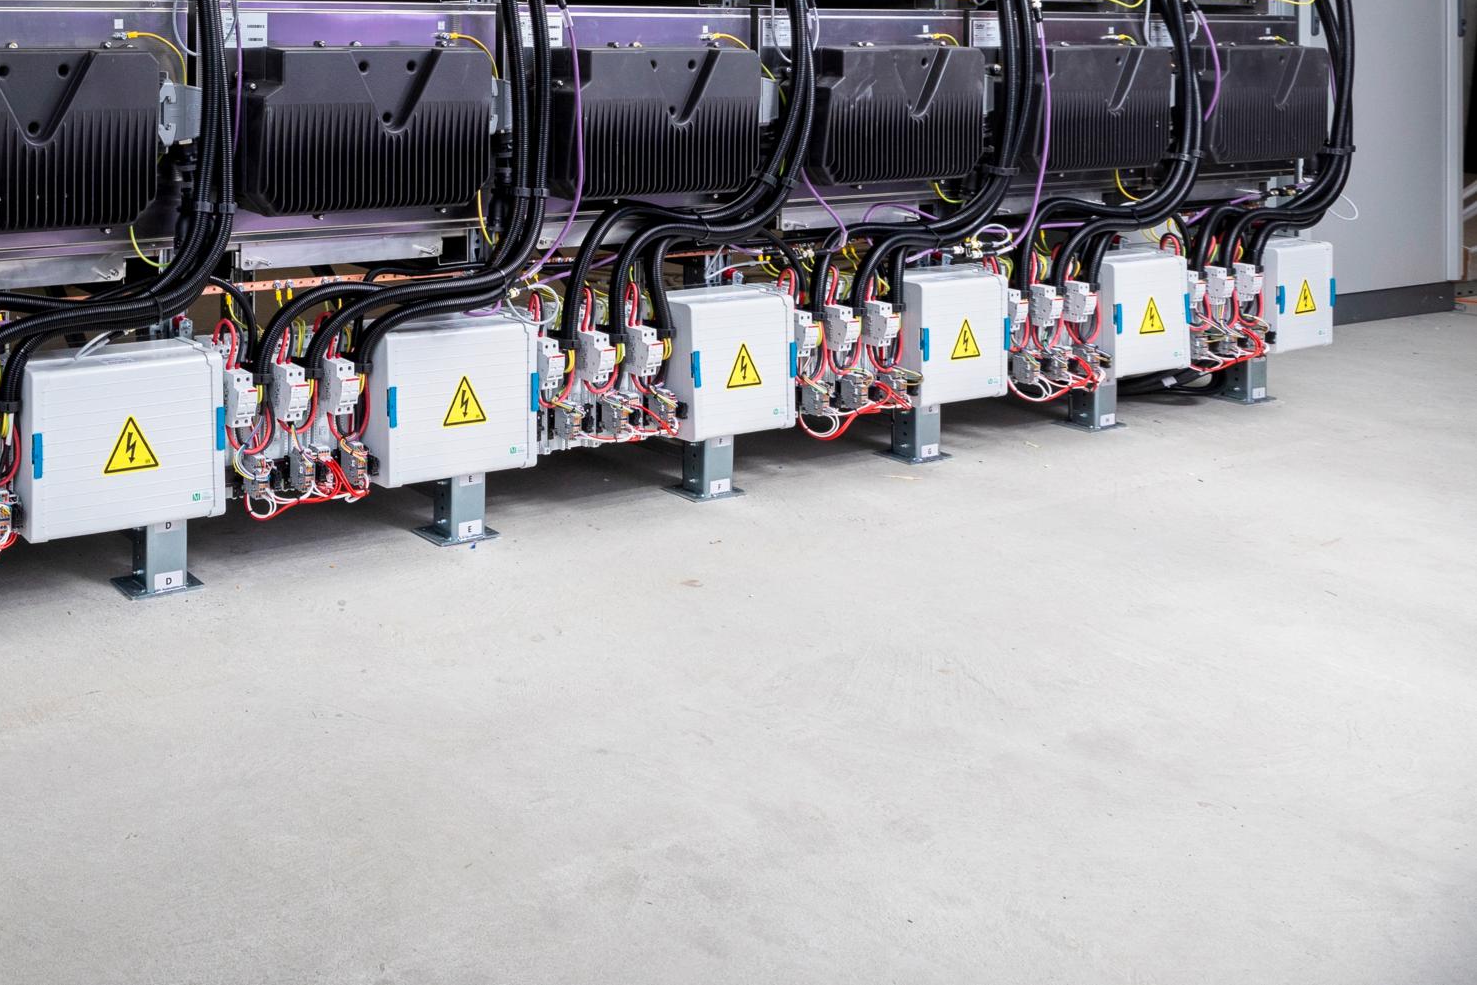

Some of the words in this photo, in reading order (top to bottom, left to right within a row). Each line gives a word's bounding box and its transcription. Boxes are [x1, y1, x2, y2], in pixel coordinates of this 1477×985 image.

[468, 475, 473, 483] E
[165, 521, 172, 529] D
[467, 525, 472, 533] E
[165, 577, 172, 585] D
